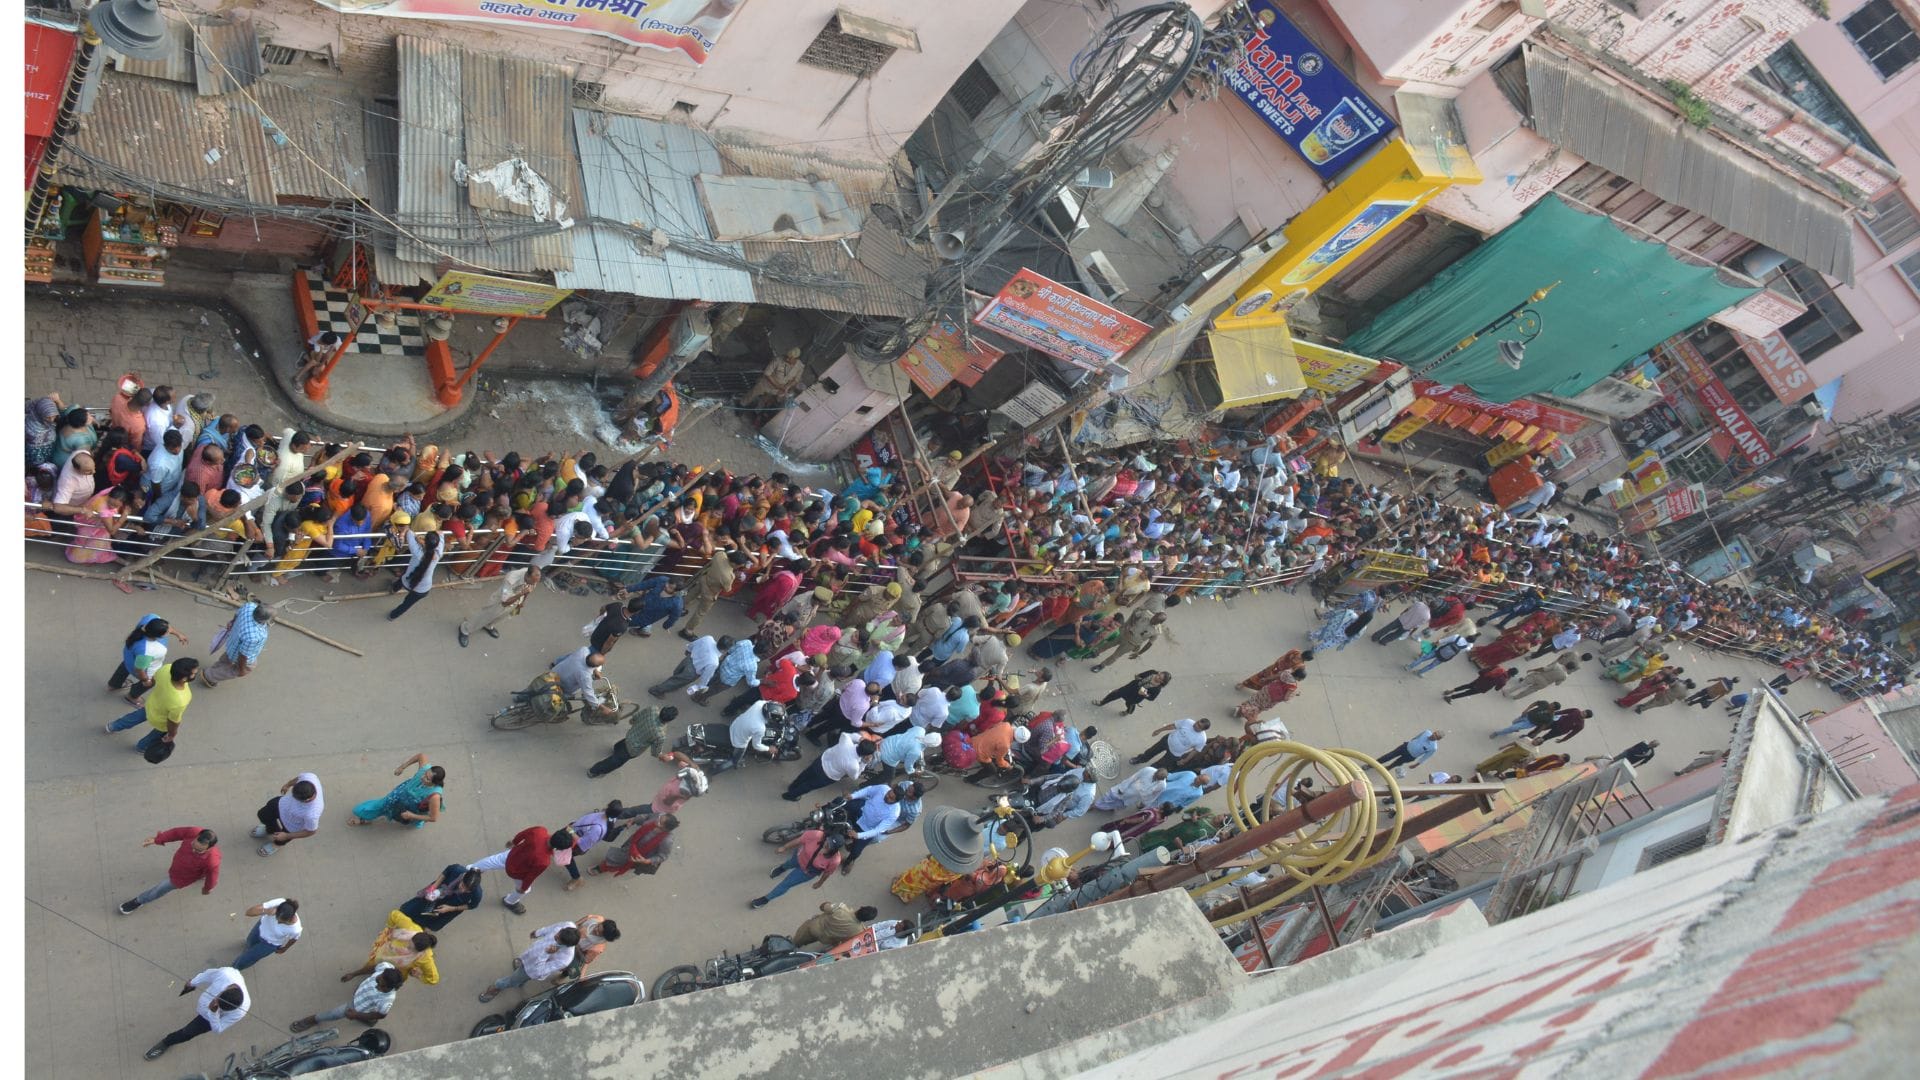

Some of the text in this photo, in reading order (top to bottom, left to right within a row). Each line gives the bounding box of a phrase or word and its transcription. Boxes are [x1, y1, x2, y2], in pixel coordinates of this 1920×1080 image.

[480, 1, 535, 16] महादेव
[538, 8, 577, 22] भक्त
[1248, 91, 1258, 101] &
[1257, 99, 1295, 135] SWEETS
[1037, 285, 1053, 300] श्री
[1048, 292, 1072, 307] काशी
[1099, 314, 1120, 329] मंदिर
[1762, 336, 1808, 389] AN'S
[1716, 406, 1771, 466] JALAN'S
